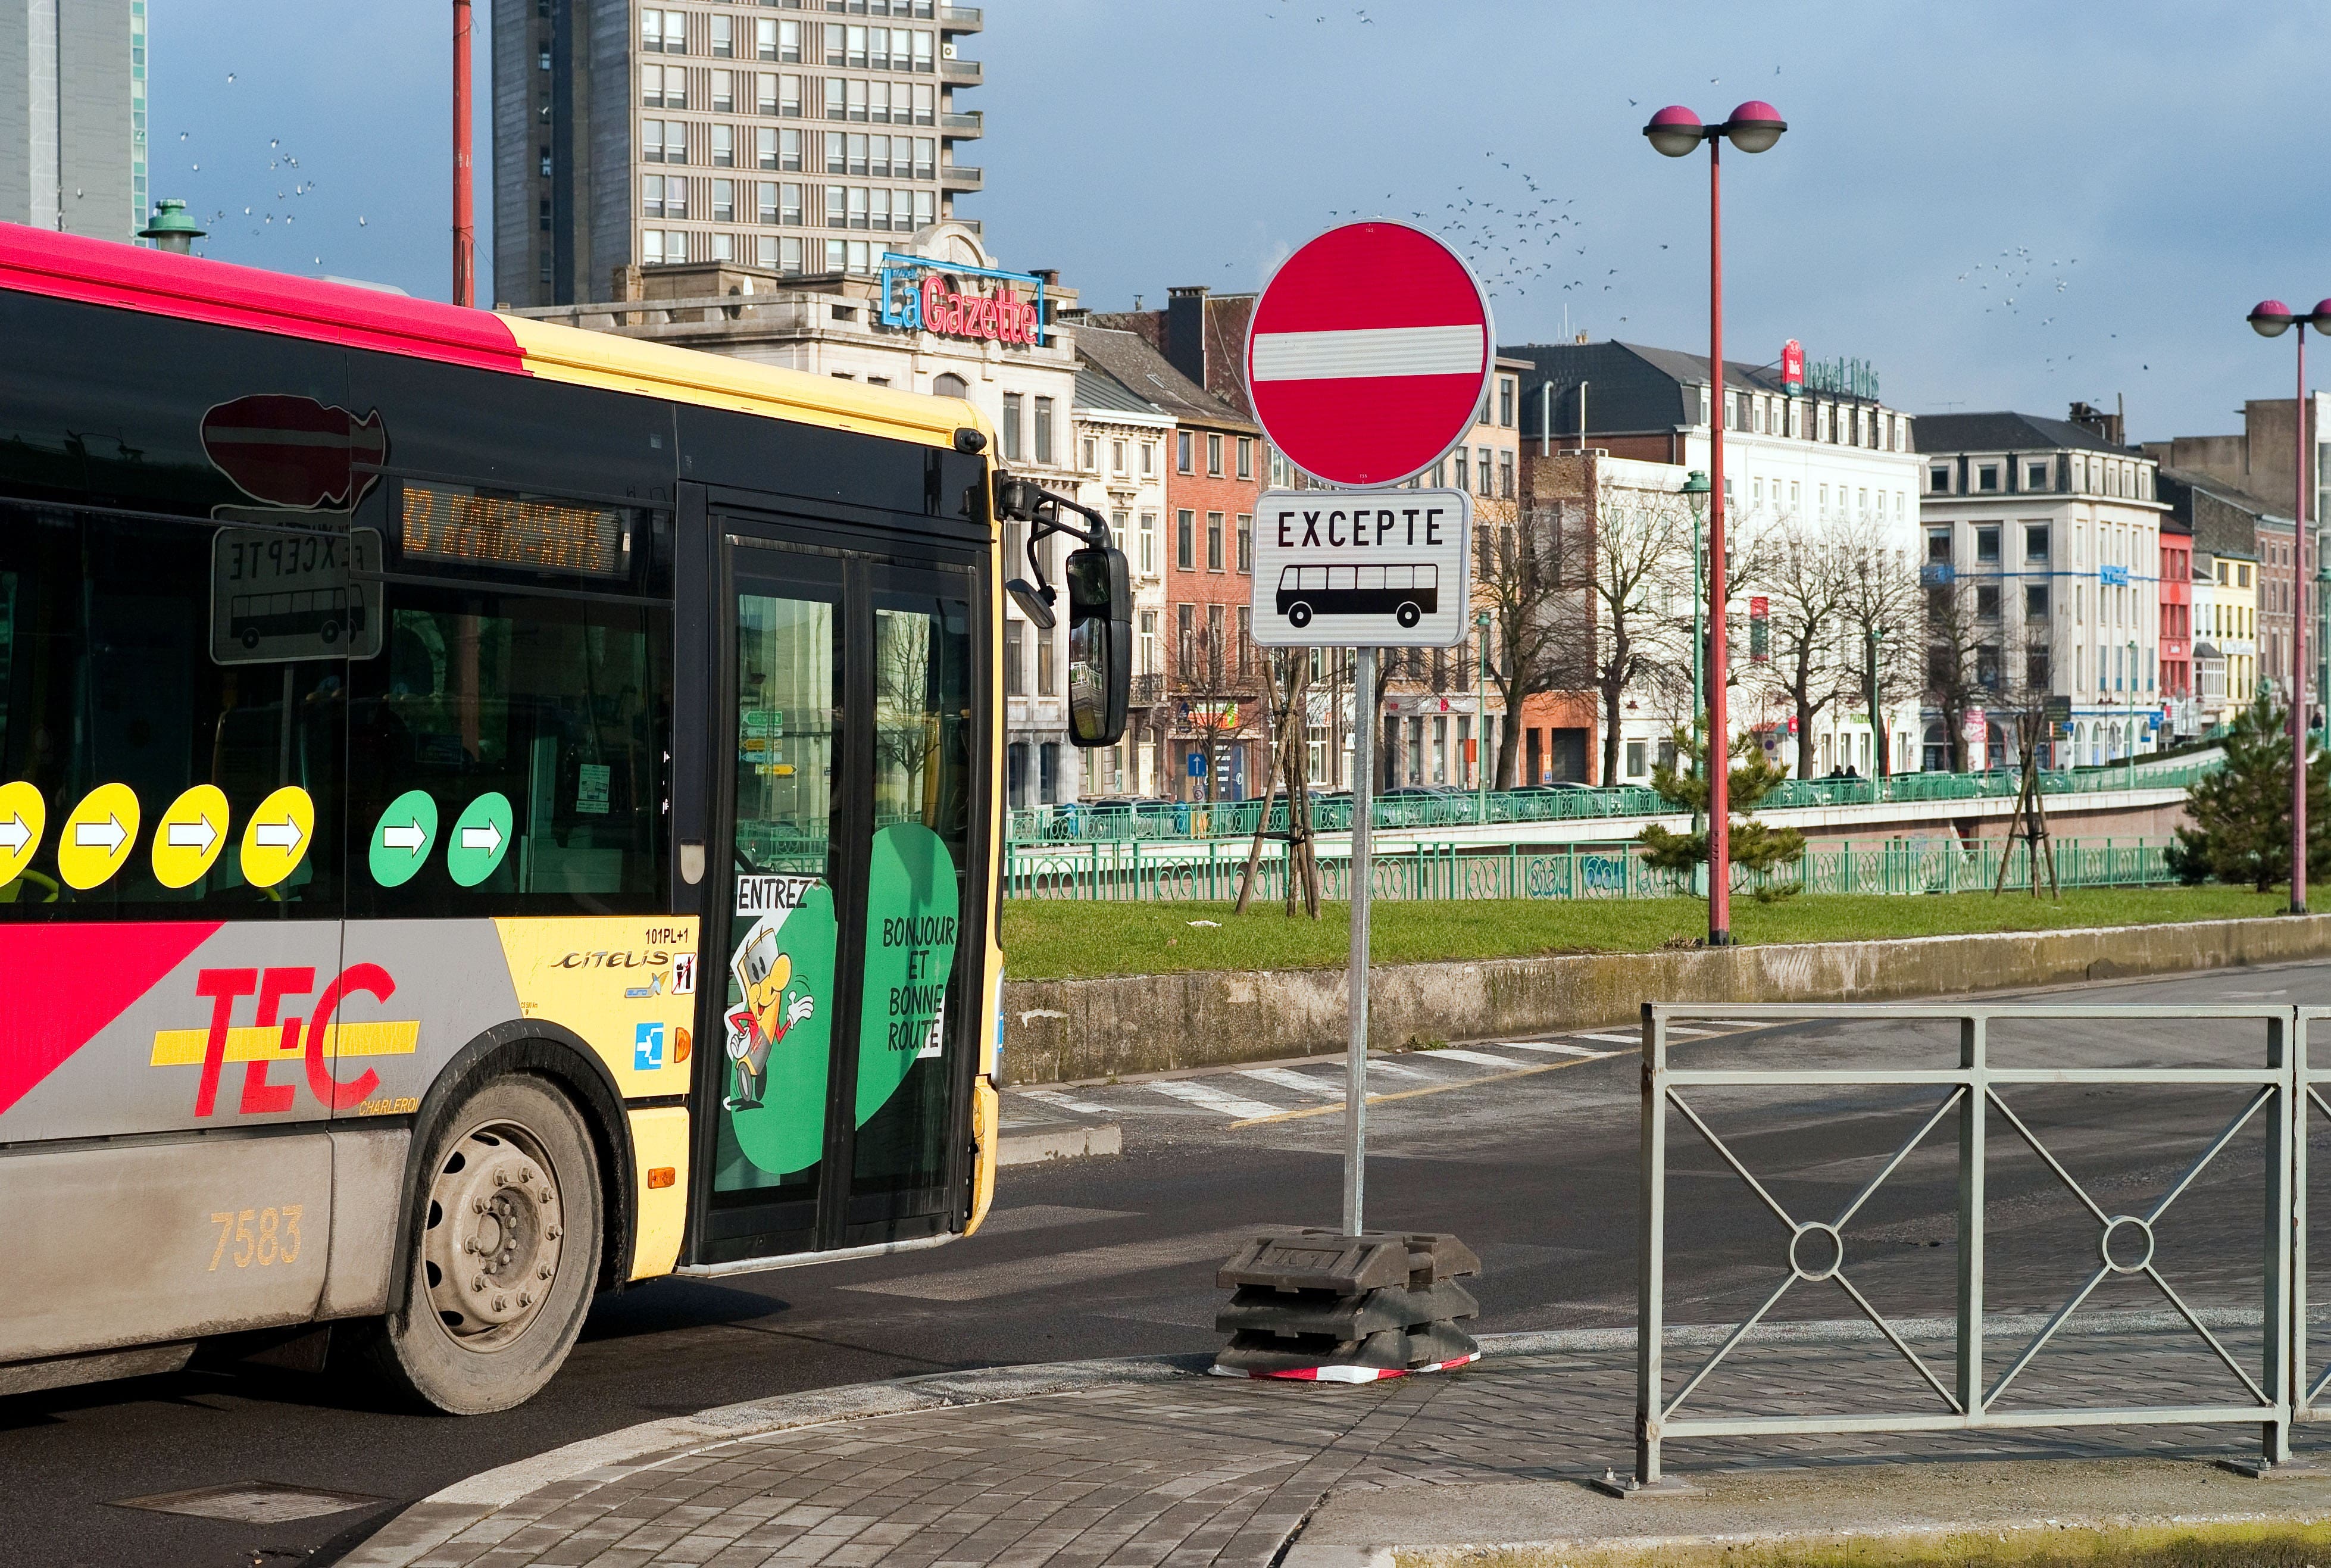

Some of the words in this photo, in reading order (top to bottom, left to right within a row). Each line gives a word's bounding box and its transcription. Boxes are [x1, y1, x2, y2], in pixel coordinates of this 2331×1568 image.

[881, 268, 923, 330] La
[922, 275, 1038, 345] Gazette
[1804, 356, 1846, 393] hotel
[1277, 508, 1444, 548] EXCEPTE
[738, 878, 811, 910] ENTREZ
[645, 927, 689, 945] 101PL+1
[883, 916, 957, 947] BONJOUR
[908, 949, 930, 980] ET
[889, 985, 943, 1017] BONNE
[194, 963, 396, 1117] TEC
[887, 1019, 940, 1052] ROUTE
[358, 1097, 420, 1117] CHARLEROI
[208, 1205, 304, 1272] 7583
